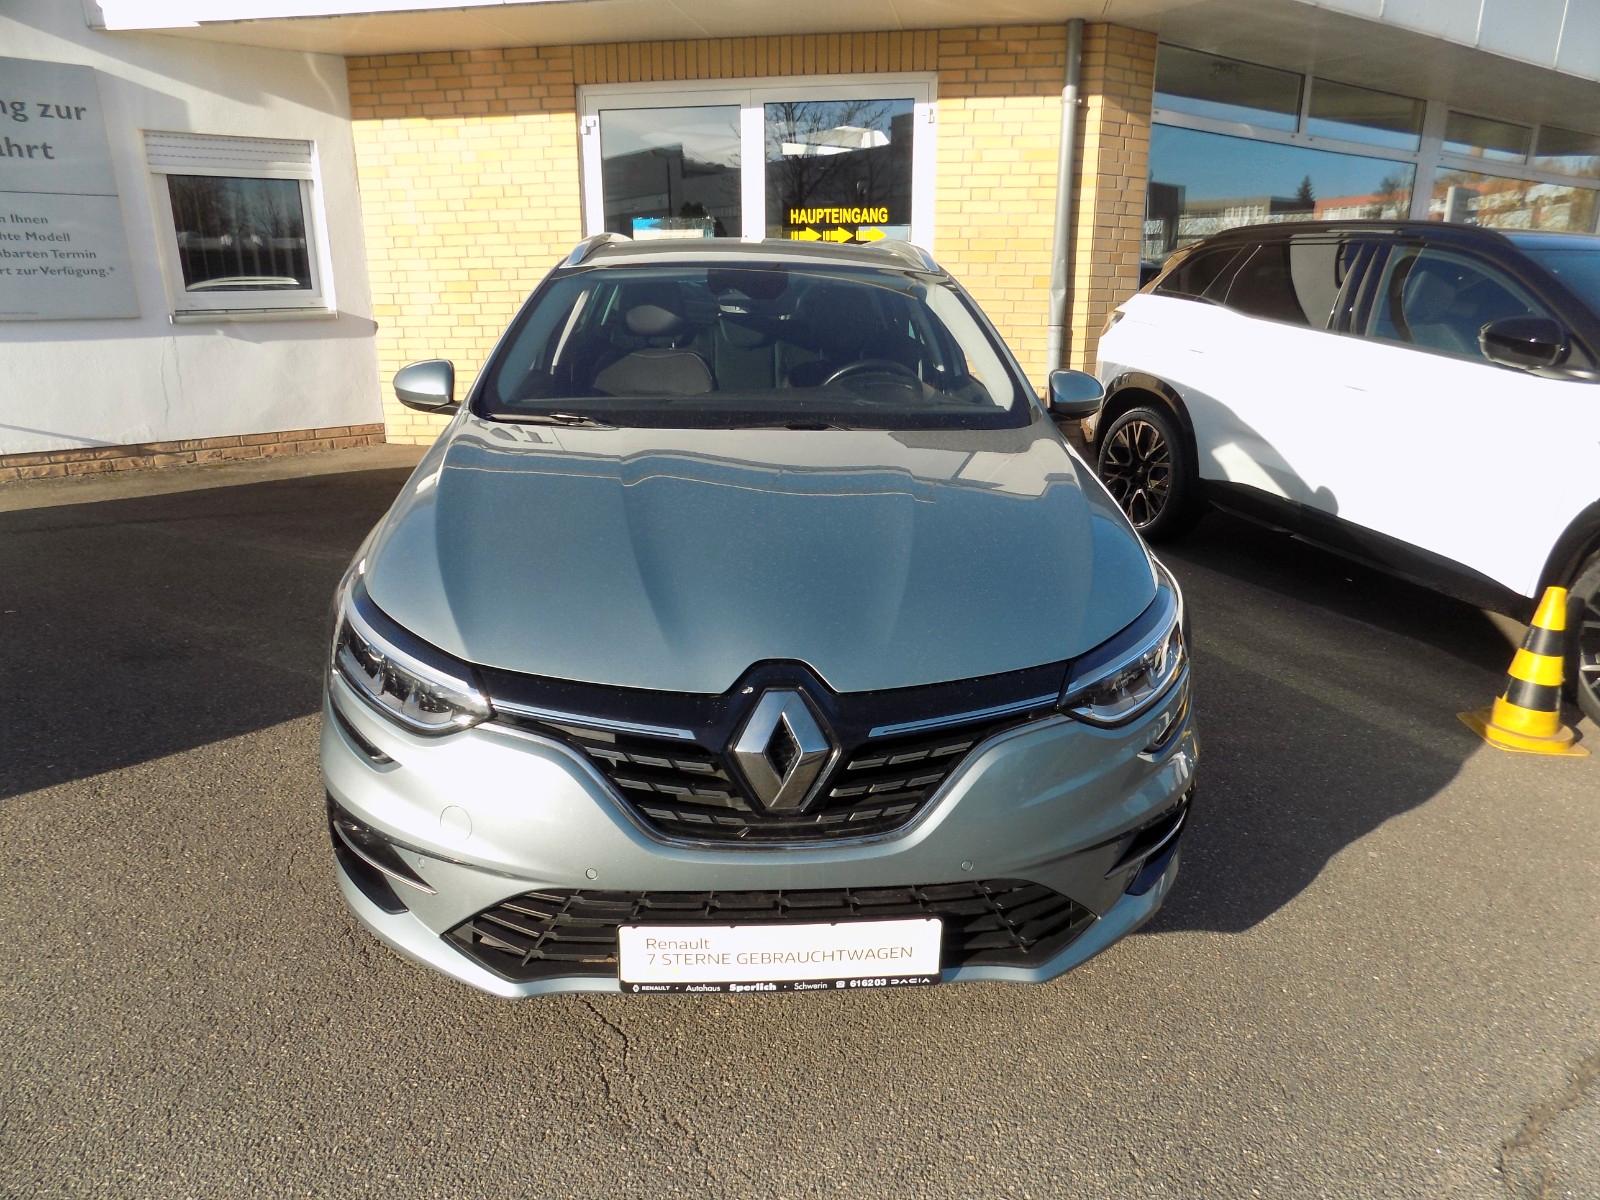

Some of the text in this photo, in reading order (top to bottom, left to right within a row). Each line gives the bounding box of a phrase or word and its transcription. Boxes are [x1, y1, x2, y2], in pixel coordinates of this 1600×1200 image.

[36, 103, 87, 120] zur
[10, 213, 49, 224] Ihnen
[790, 207, 889, 224] HAUPTEINGANG
[25, 231, 71, 242] Modell
[49, 249, 97, 259] Termin
[646, 937, 710, 951] Renault
[648, 946, 913, 966] 7 STERNE GEBRAUCHTWAGEN
[685, 983, 721, 993] Autohaus
[729, 982, 777, 993] Sperlich
[794, 981, 828, 991] Schwerin
[850, 978, 887, 988] 616203
[890, 977, 931, 985] DACIA
